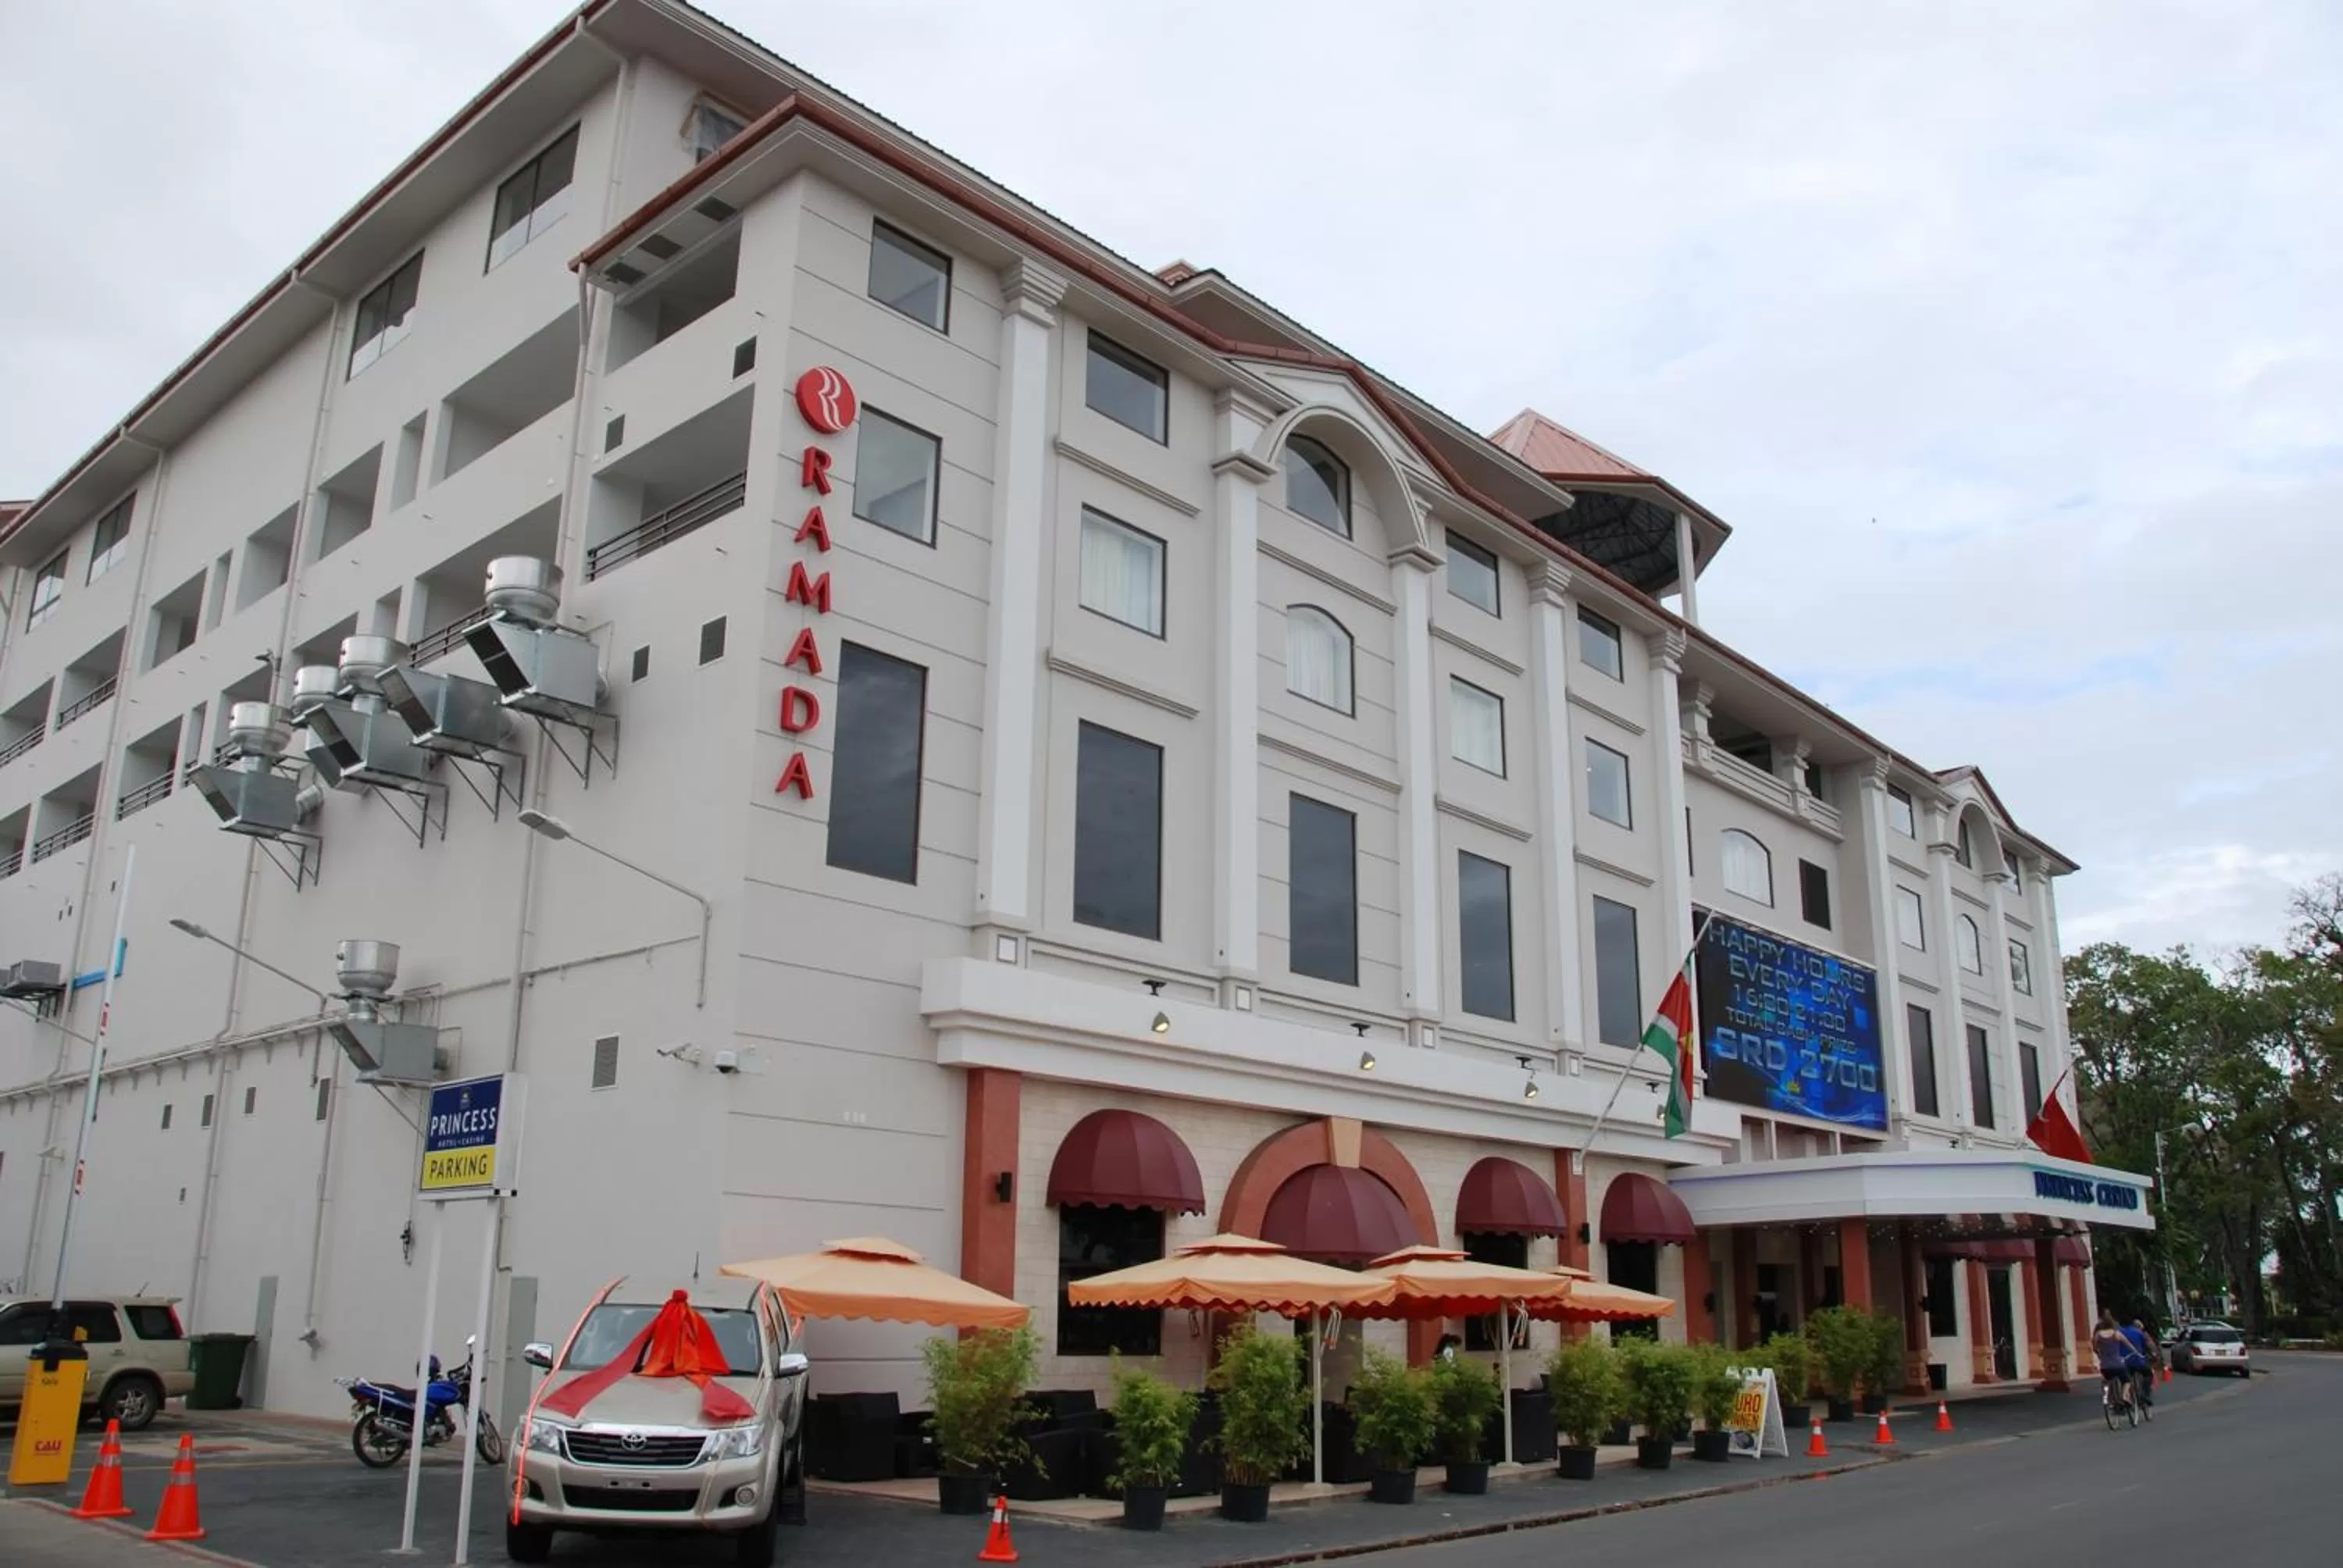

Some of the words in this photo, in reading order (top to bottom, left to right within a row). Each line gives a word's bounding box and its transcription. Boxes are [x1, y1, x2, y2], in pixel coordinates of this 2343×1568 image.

[775, 445, 833, 800] RAMADA
[1707, 920, 1785, 966] HAPPY
[1729, 953, 1804, 995] EVERY
[1811, 981, 1850, 1011] DAY
[1725, 1005, 1774, 1032] TOTAL
[1716, 1026, 1787, 1071] SRD
[1799, 1049, 1877, 1093] 2700
[430, 1107, 497, 1137] PRINCESS
[430, 1154, 488, 1180] PARKING
[1735, 1392, 1762, 1413] URO
